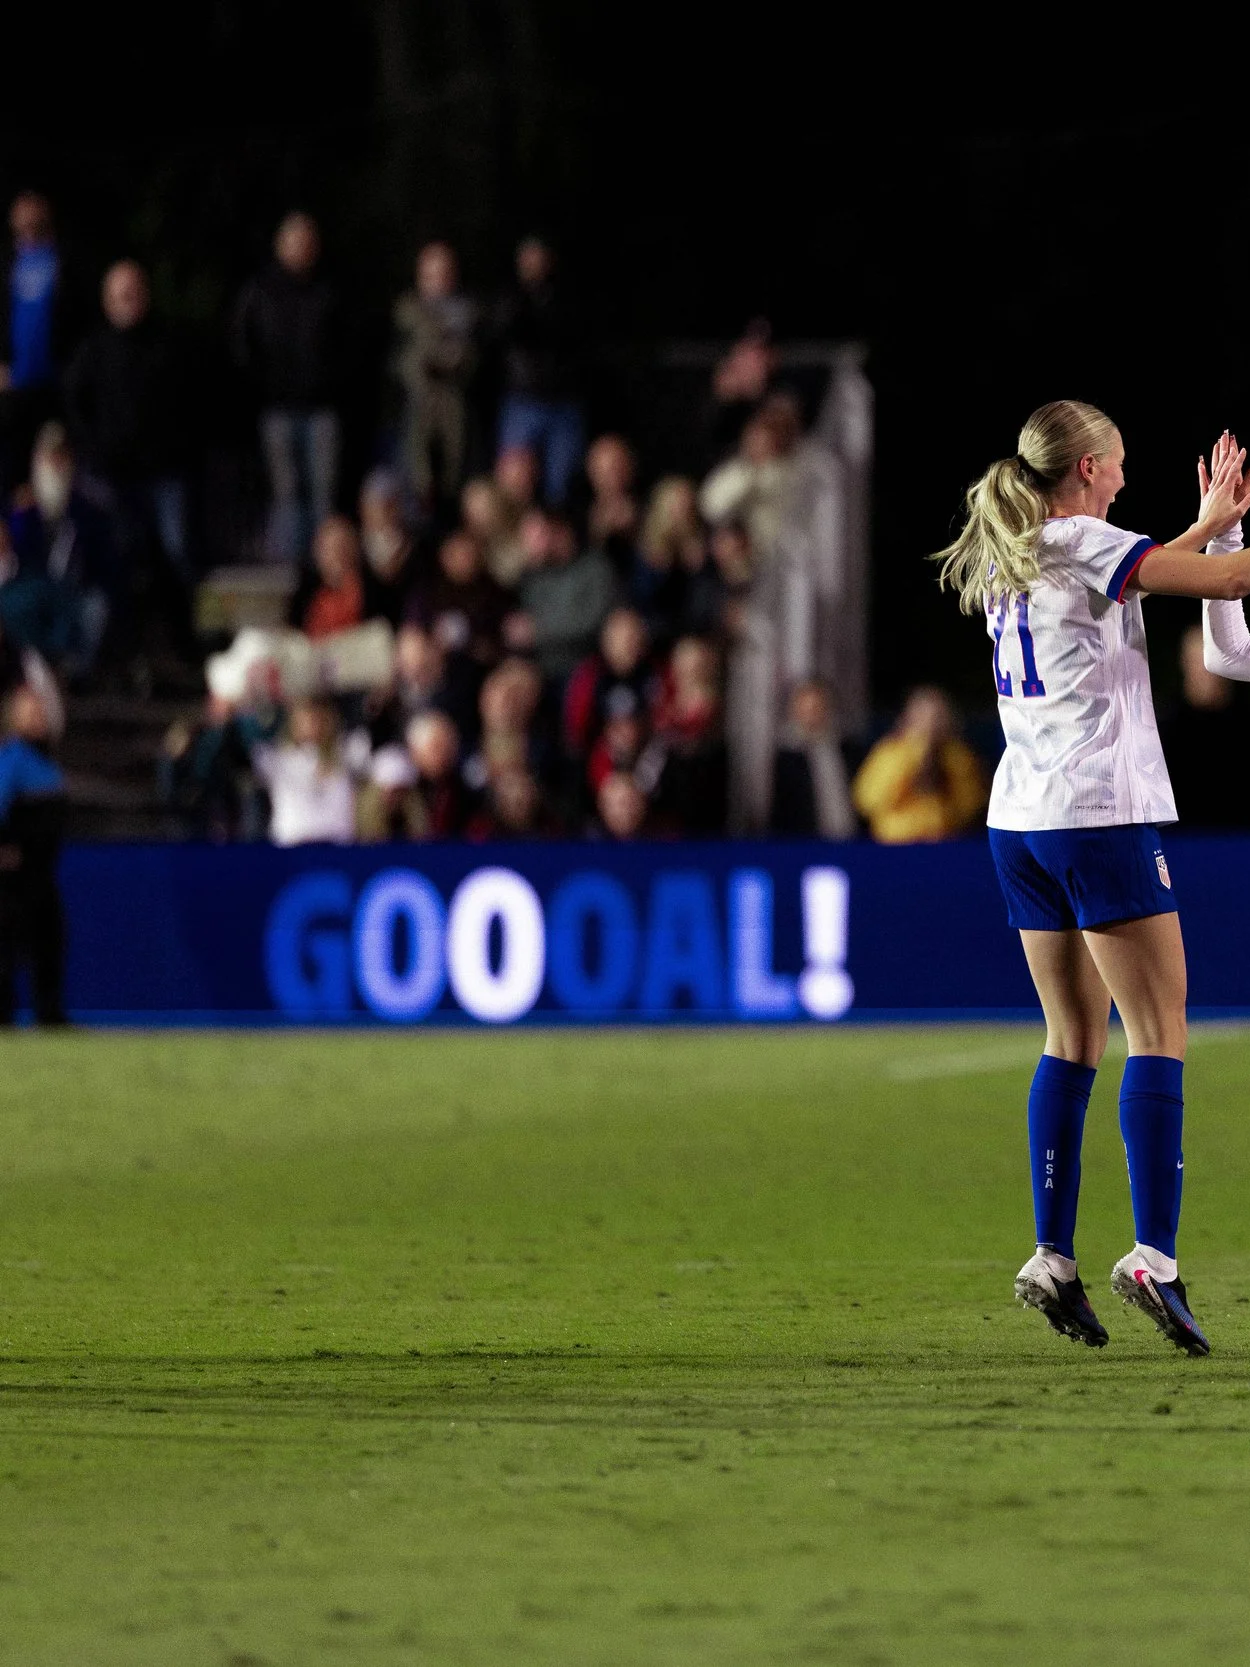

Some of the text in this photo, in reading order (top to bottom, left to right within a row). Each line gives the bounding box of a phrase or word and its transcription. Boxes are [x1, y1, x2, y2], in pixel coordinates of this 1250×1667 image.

[986, 588, 1046, 697] 21
[264, 866, 854, 1022] GOOOAL!
[1045, 1149, 1054, 1189] USA
